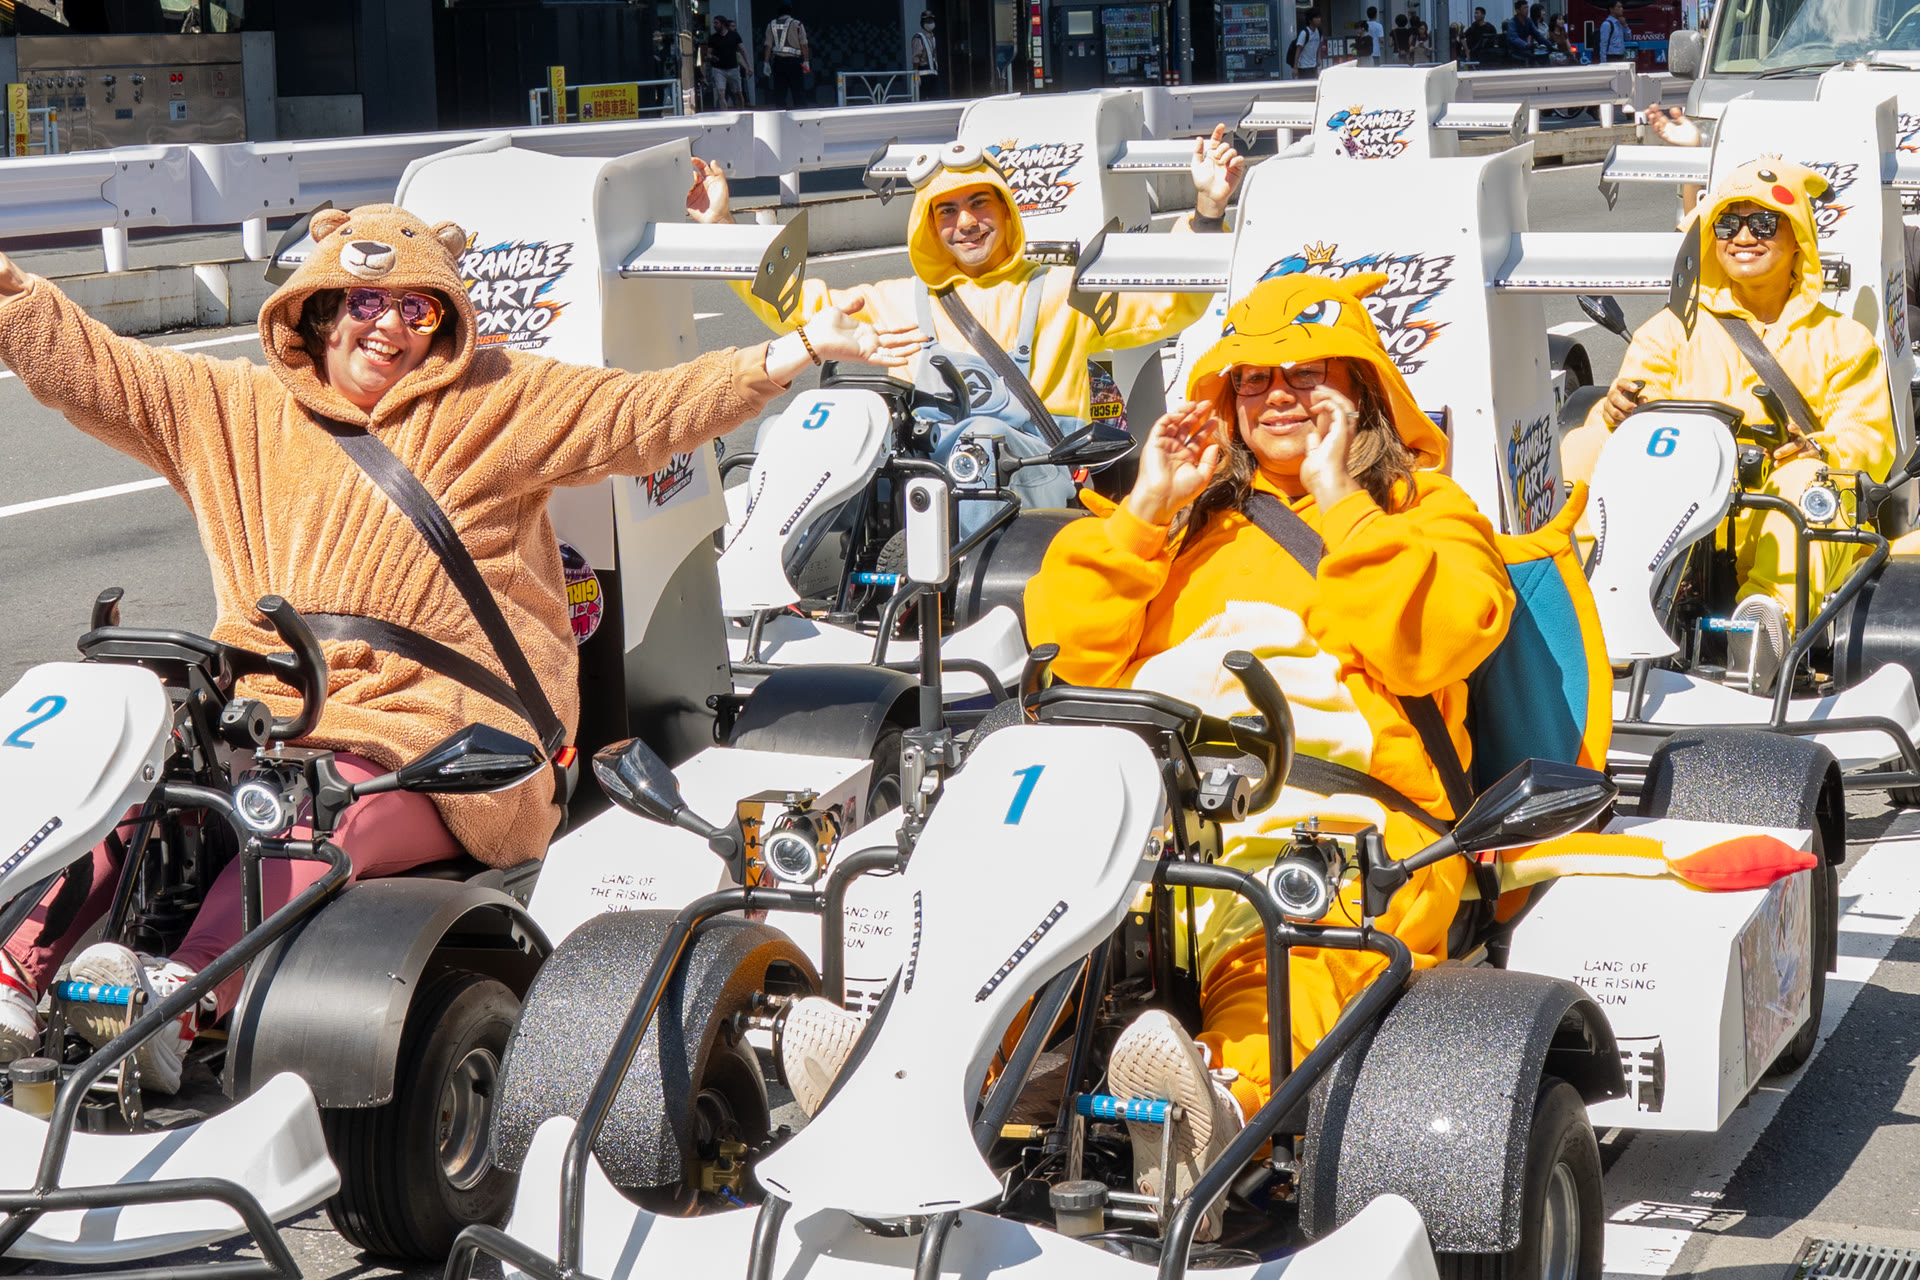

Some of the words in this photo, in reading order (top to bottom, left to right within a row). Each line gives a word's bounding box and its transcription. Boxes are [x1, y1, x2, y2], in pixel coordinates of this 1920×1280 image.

[1351, 126, 1406, 144] ART
[1003, 165, 1072, 188] ART
[1011, 184, 1073, 206] OKYO
[459, 243, 574, 280] RAMBLE
[466, 277, 556, 309] ART
[476, 307, 553, 334] OKYO
[802, 402, 836, 430] 5
[1646, 427, 1680, 457] 6
[2, 695, 67, 749] 2
[1003, 764, 1046, 825] 1
[602, 873, 635, 885] LAND
[639, 877, 656, 886] OF
[591, 887, 612, 898] THE
[616, 889, 657, 901] RISING
[843, 906, 869, 918] AND
[874, 910, 890, 920] OF
[849, 922, 893, 937] RISING
[1584, 960, 1623, 972] LAND
[1630, 962, 1648, 973] OF
[1573, 976, 1598, 988] THE
[1605, 977, 1656, 991] RISING
[1597, 994, 1627, 1006] SUN
